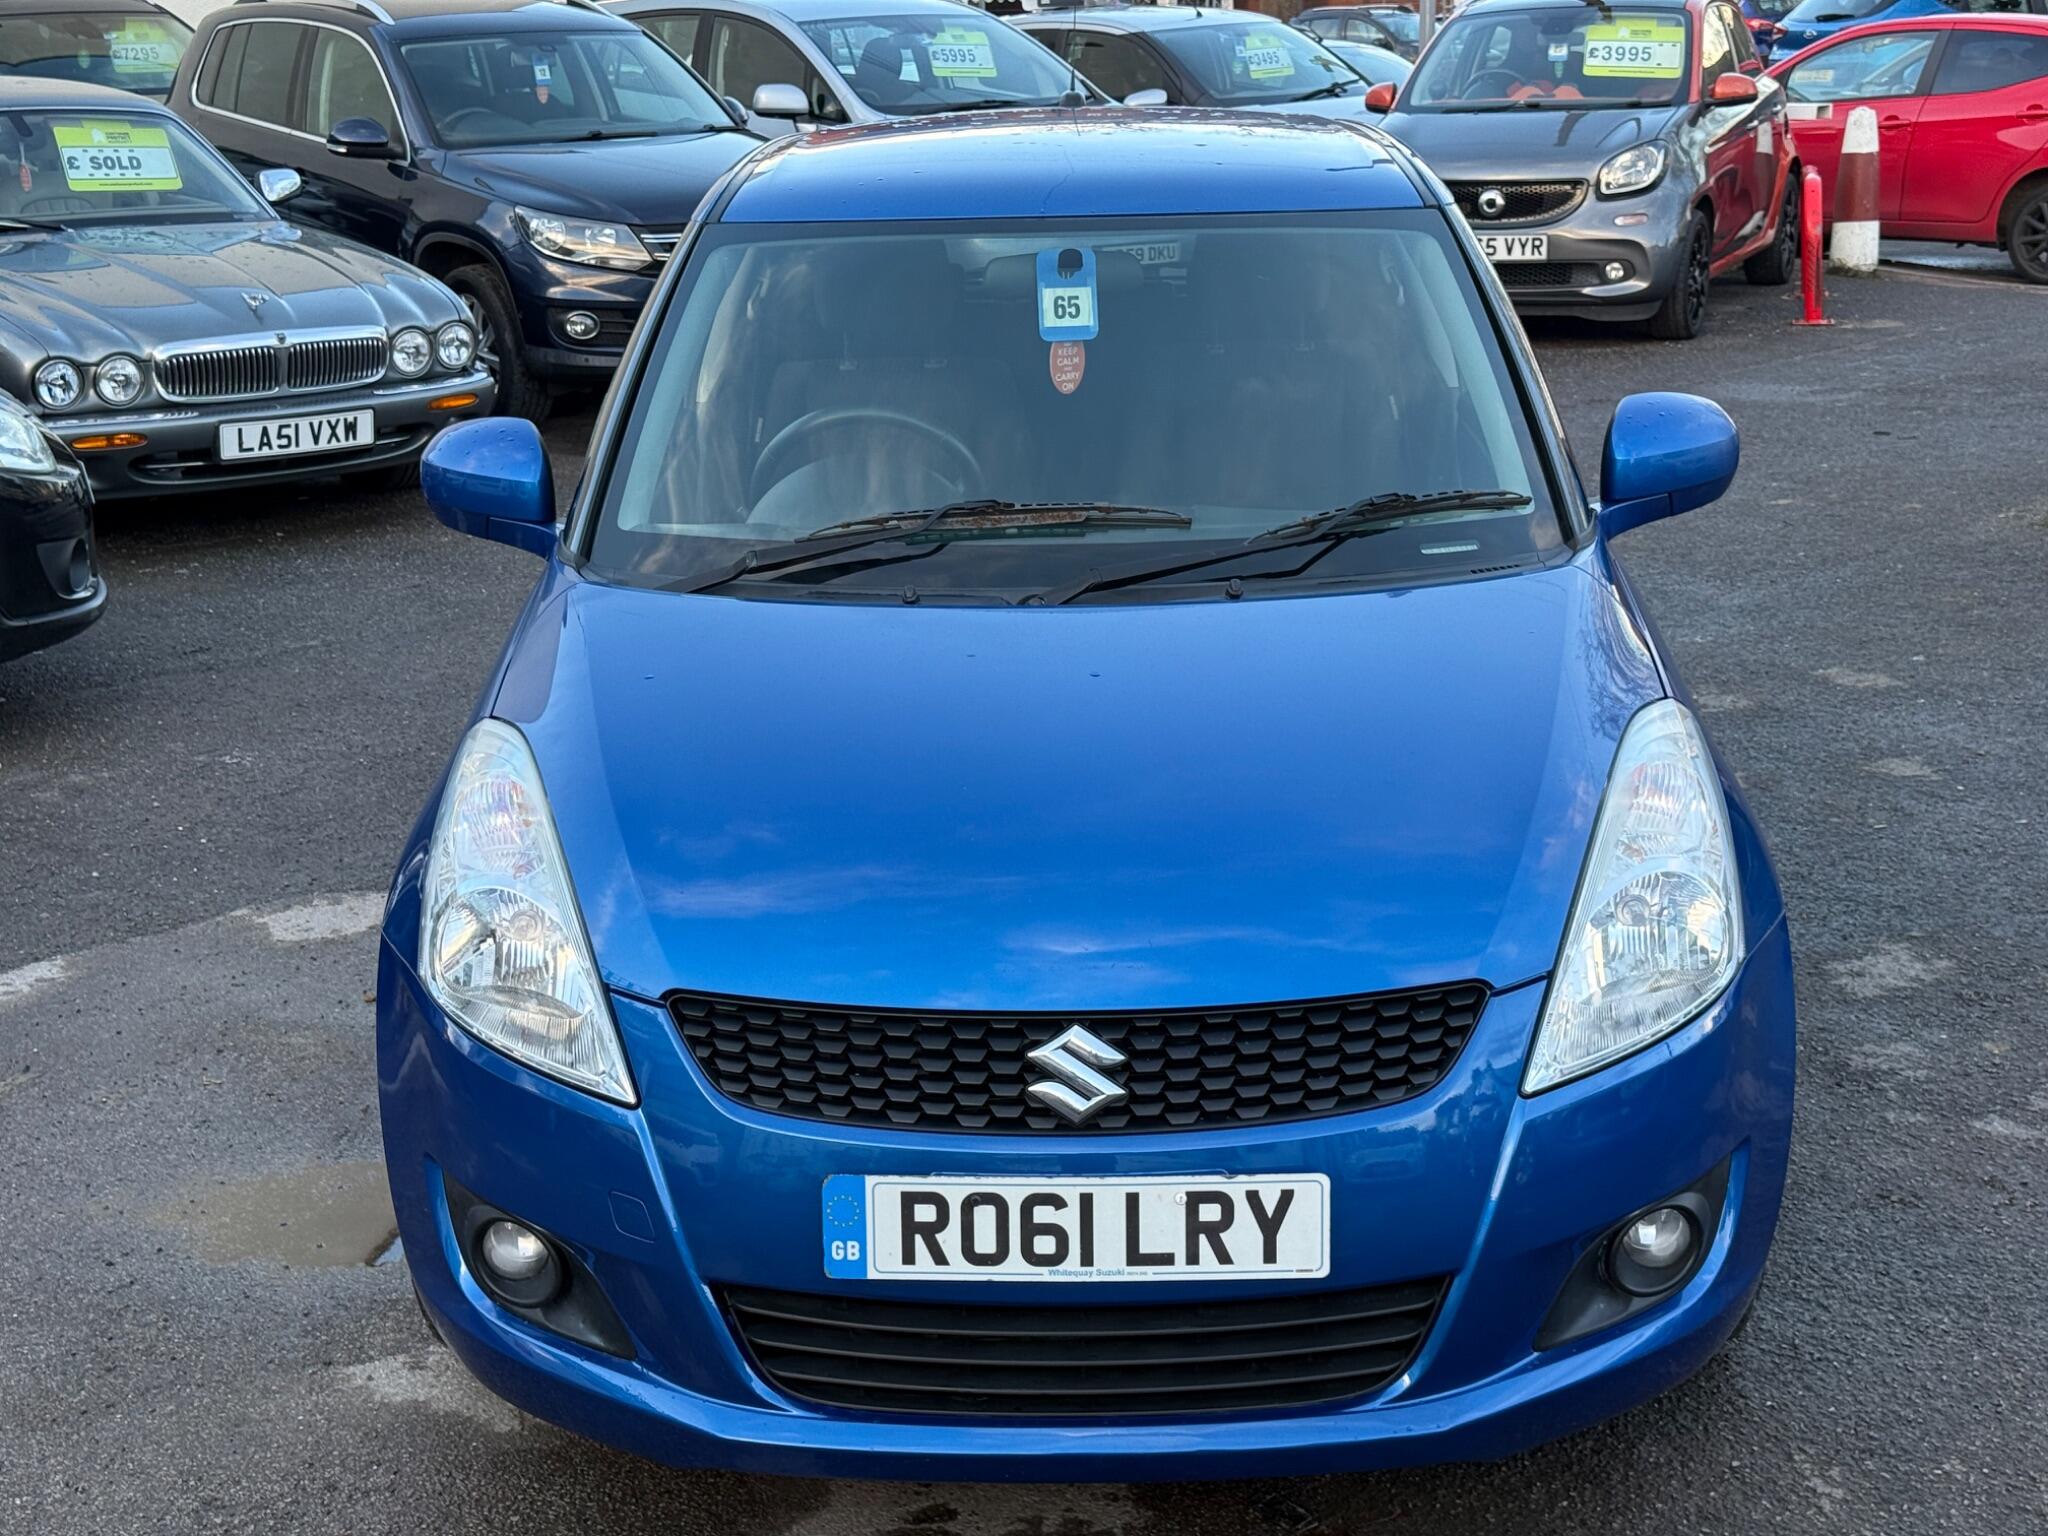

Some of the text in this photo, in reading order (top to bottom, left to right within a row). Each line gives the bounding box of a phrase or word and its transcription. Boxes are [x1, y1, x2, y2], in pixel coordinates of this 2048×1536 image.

[112, 47, 160, 61] £7295
[931, 48, 976, 63] £5995
[1247, 51, 1280, 66] £3495
[1587, 45, 1653, 62] £3995
[66, 155, 142, 170] £ SOLD
[1148, 245, 1176, 261] DKU
[1504, 237, 1543, 256] VYR
[1053, 295, 1081, 319] 65
[1057, 356, 1079, 366] CALM
[1062, 382, 1075, 391] ON
[237, 416, 358, 453] LA51 VXW
[900, 1189, 1295, 1268] RO61 LRY
[831, 1240, 860, 1261] GB
[1047, 1268, 1094, 1278] Whitequay
[1095, 1268, 1125, 1276] Suzuki
